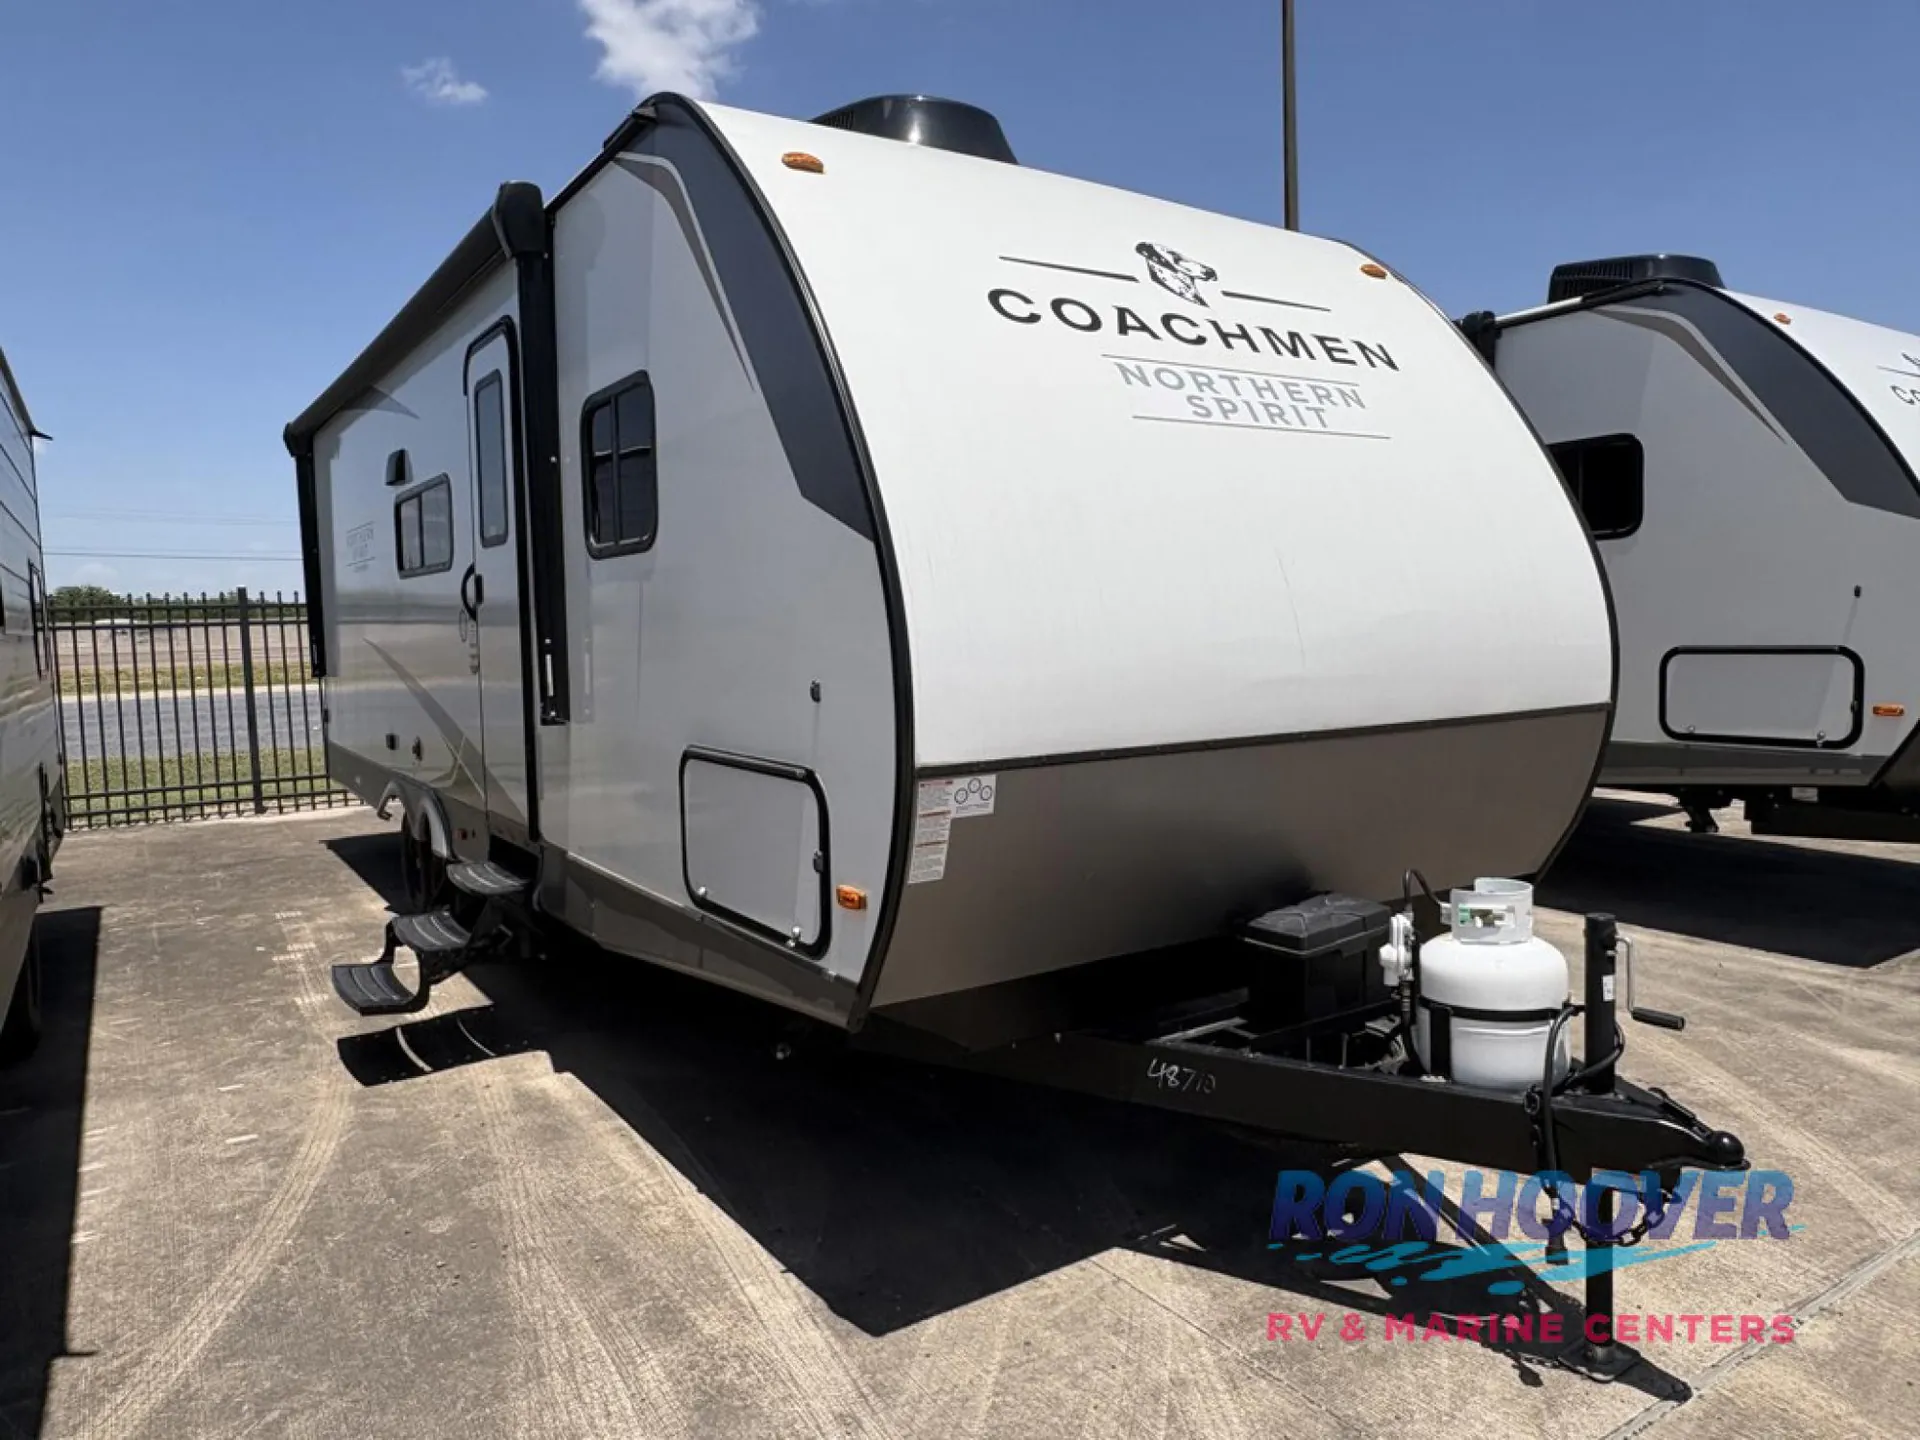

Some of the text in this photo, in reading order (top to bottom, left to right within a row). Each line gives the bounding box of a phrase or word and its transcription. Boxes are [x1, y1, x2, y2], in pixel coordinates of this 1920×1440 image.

[988, 288, 1399, 371] COACHMEN
[1114, 362, 1366, 409] NORTHERN
[1187, 396, 1328, 428] SPIRIT
[1146, 1058, 1217, 1094] 48710
